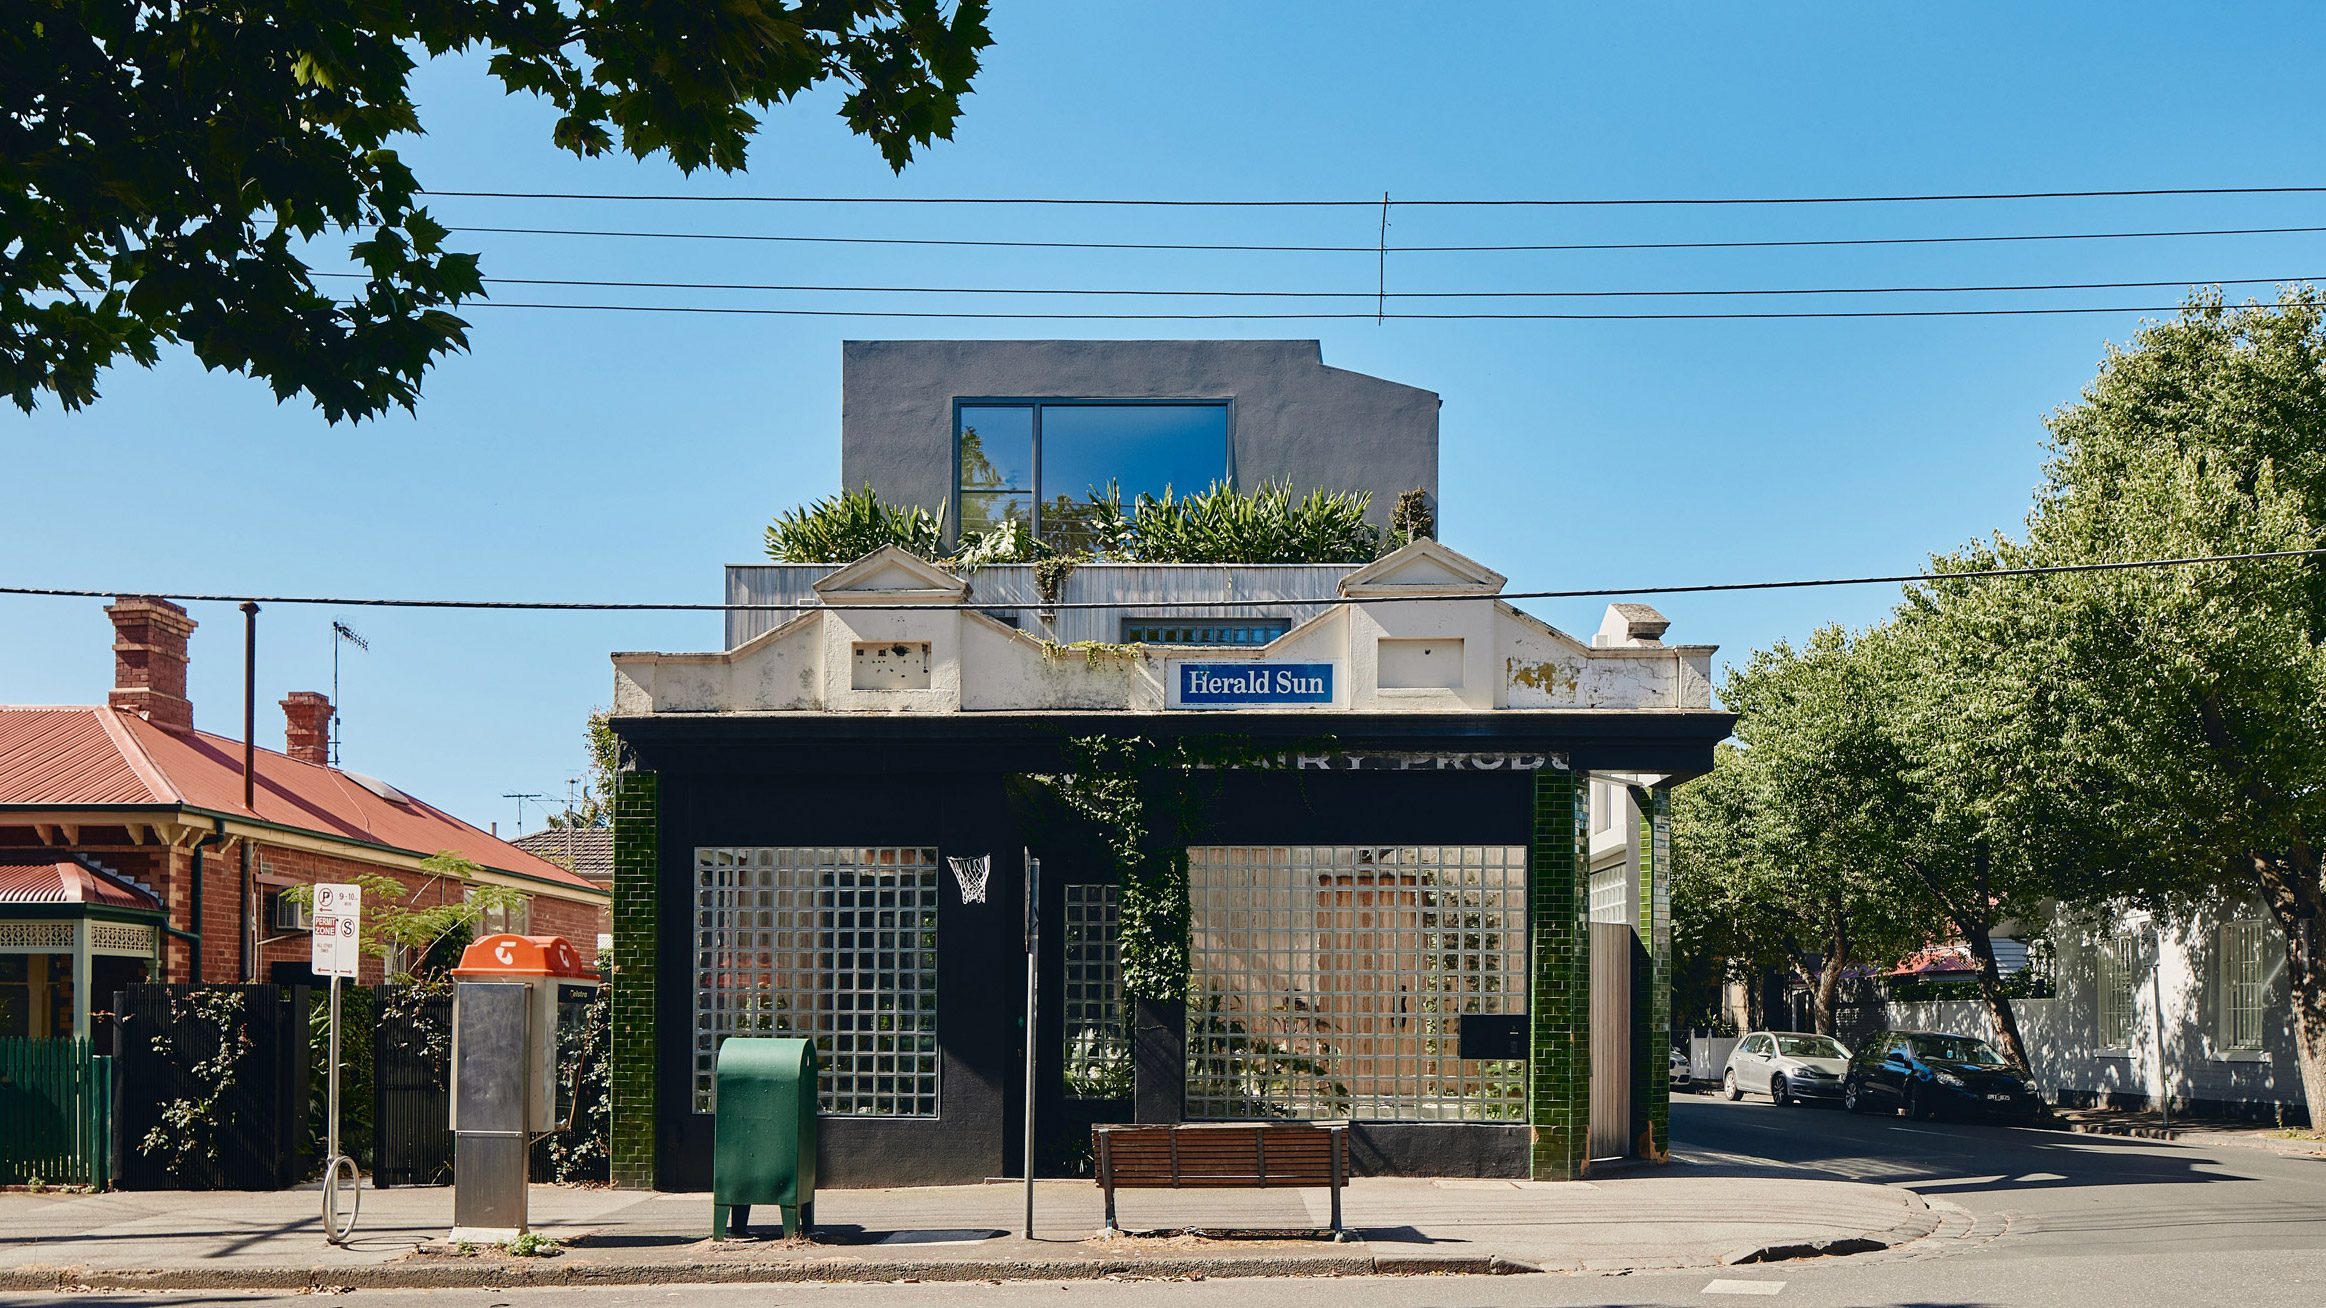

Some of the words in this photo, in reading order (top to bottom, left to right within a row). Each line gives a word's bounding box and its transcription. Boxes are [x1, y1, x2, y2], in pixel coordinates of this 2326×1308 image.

[1189, 671, 1270, 694] Herald
[1276, 671, 1325, 694] Sun
[315, 917, 336, 926] PERMIT
[315, 927, 336, 936] ZONE
[343, 921, 352, 935] S
